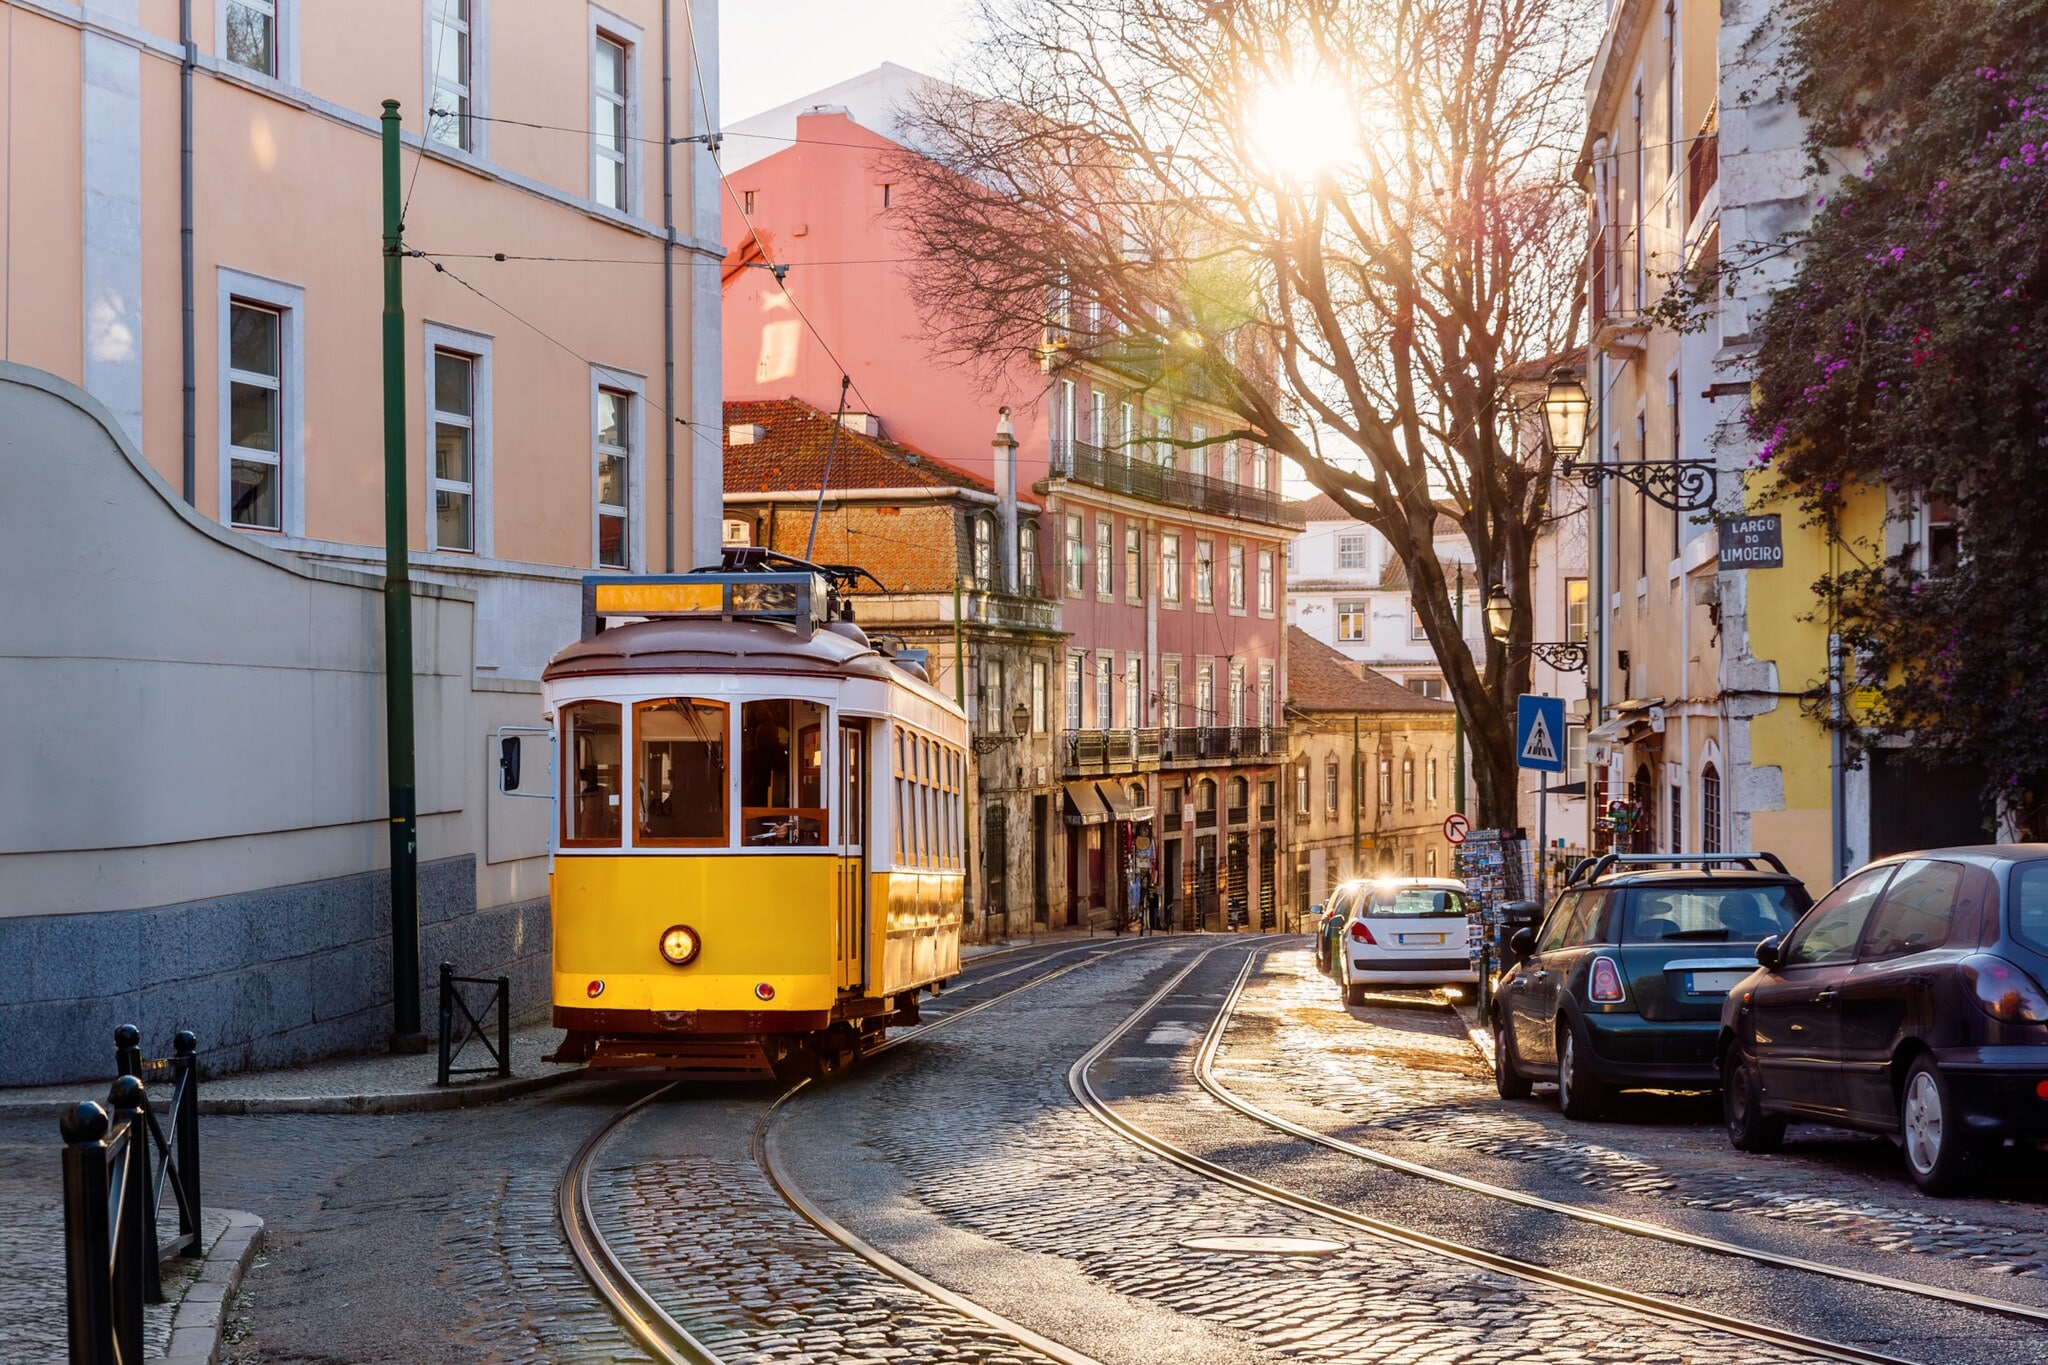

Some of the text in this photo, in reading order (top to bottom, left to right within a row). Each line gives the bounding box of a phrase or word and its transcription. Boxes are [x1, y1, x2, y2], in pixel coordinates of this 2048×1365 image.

[1732, 520, 1775, 533] LARGO
[1745, 535, 1759, 543] DO
[1721, 546, 1781, 562] LIMOEIRO
